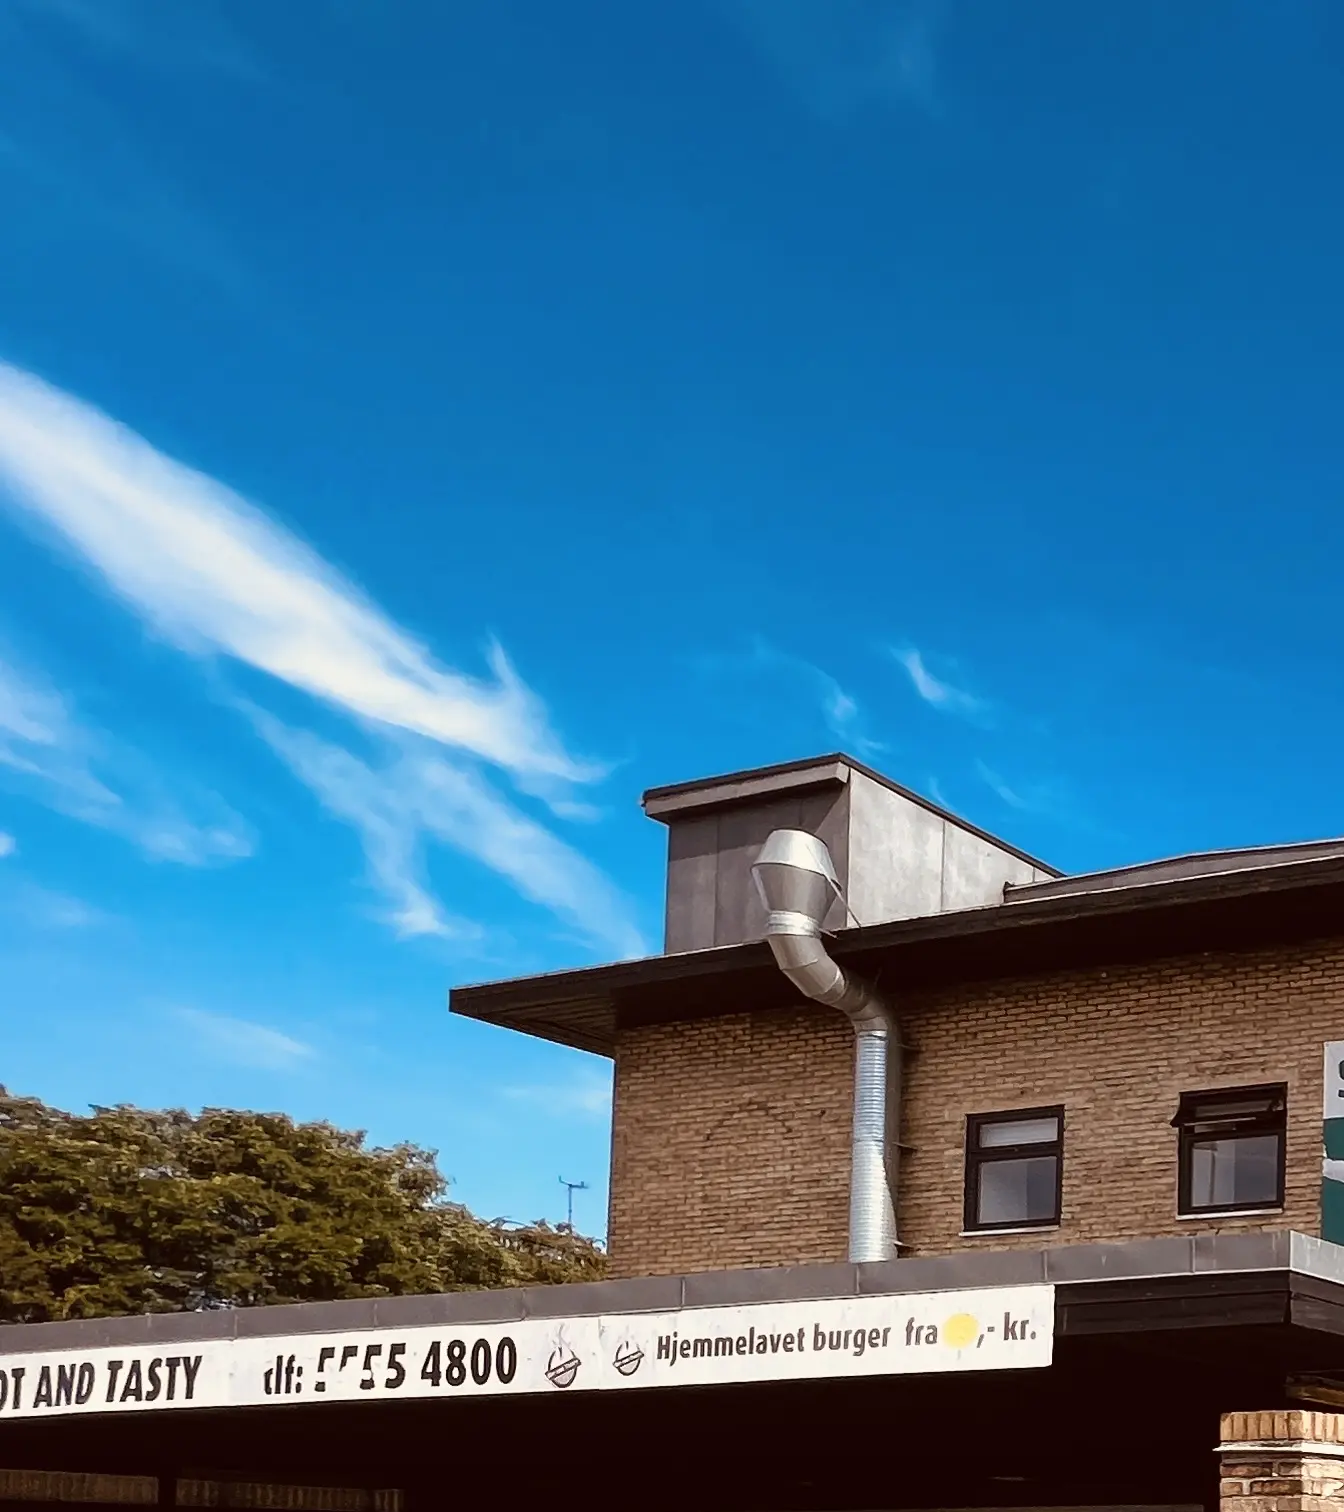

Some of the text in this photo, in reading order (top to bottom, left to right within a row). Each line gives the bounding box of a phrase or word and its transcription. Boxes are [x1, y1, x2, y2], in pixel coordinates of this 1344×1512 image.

[420, 1336, 518, 1388] 4800
[656, 1327, 806, 1367] Hjemmelavet
[812, 1323, 892, 1358] burger
[904, 1317, 939, 1347] fra
[1003, 1311, 1037, 1341] kr.
[32, 1361, 96, 1409] AND
[105, 1355, 203, 1403] TASTY
